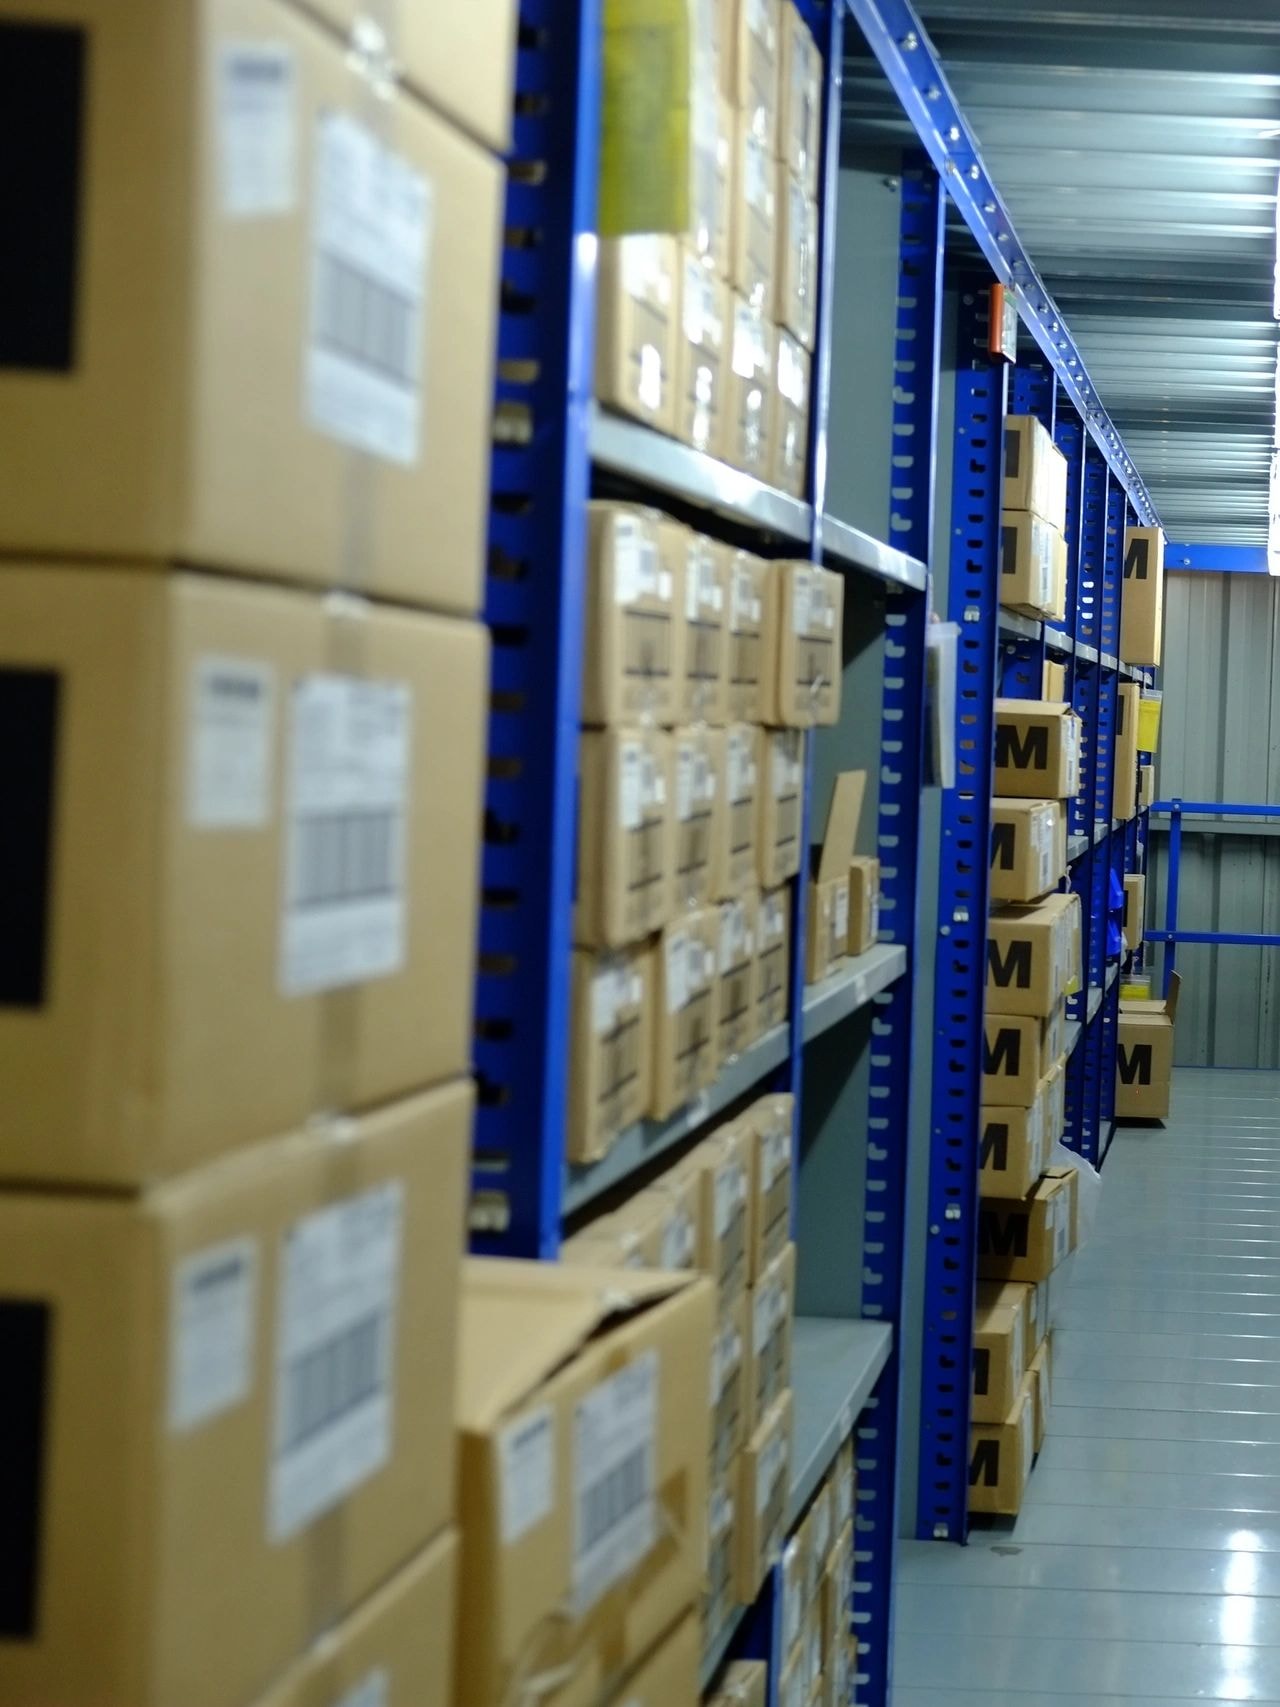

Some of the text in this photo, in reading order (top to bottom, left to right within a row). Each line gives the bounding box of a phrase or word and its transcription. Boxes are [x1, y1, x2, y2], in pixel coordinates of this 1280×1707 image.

[996, 725, 1048, 770] M
[986, 939, 1032, 988] M
[1117, 1044, 1152, 1085] M
